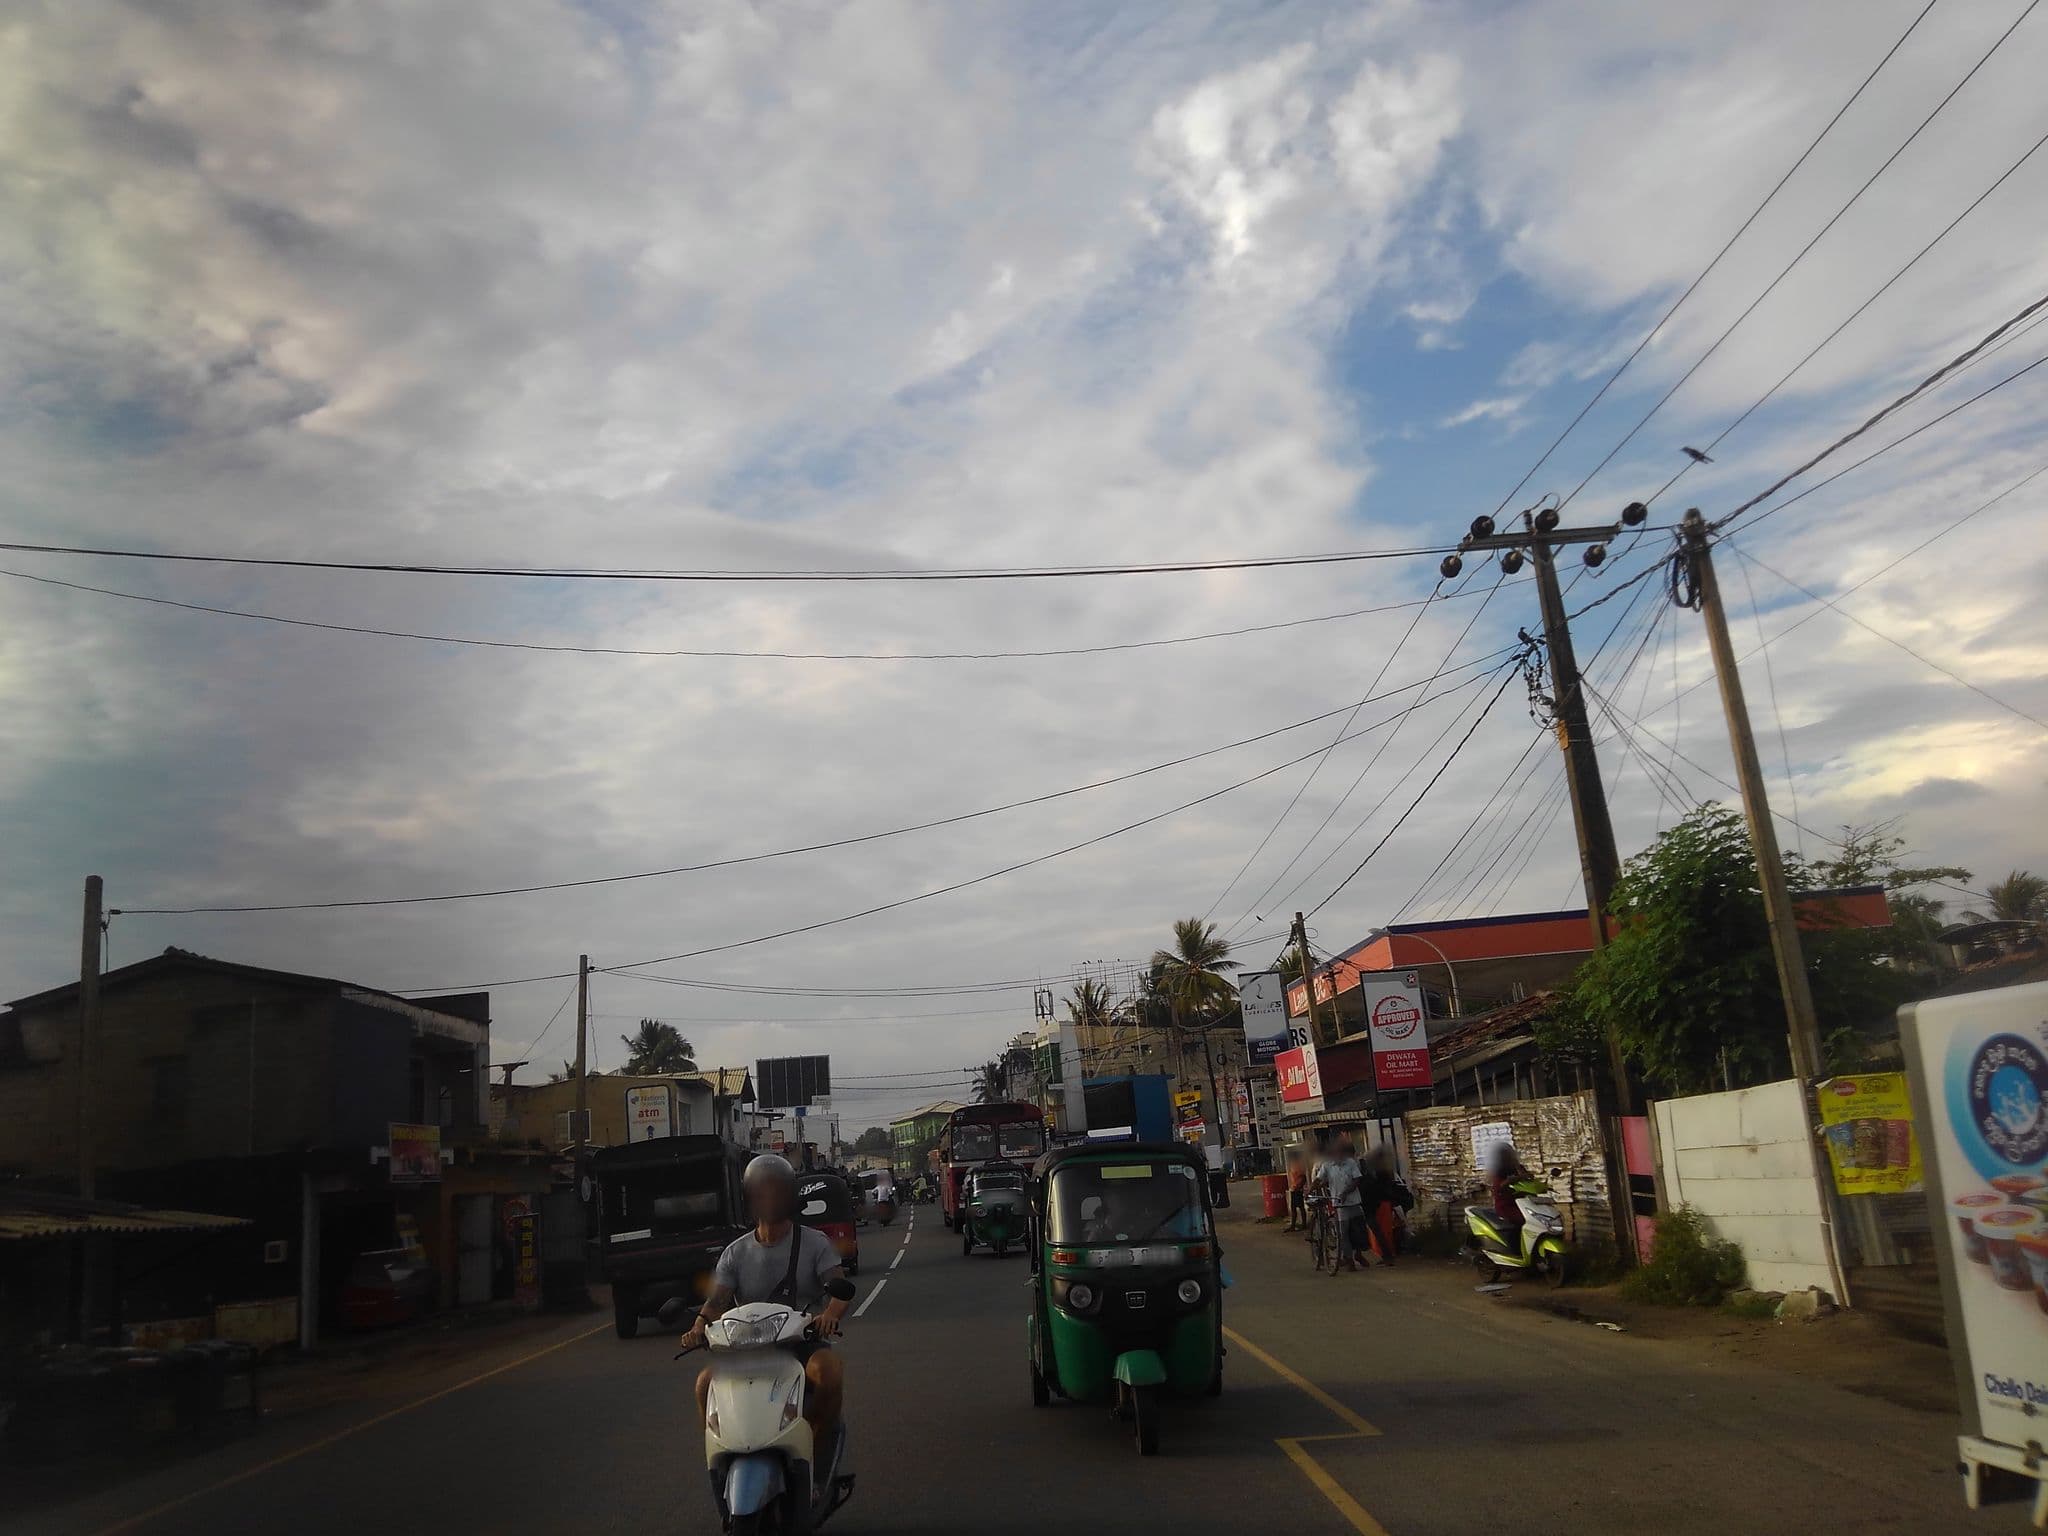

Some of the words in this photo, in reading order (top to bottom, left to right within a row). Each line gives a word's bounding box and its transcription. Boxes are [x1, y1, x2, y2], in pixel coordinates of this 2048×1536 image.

[1377, 1011, 1416, 1025] APPROVED
[1386, 1061, 1398, 1070] OIL
[1398, 1059, 1419, 1069] MART
[638, 1108, 660, 1119] atm
[1985, 1373, 2023, 1400] Chello
